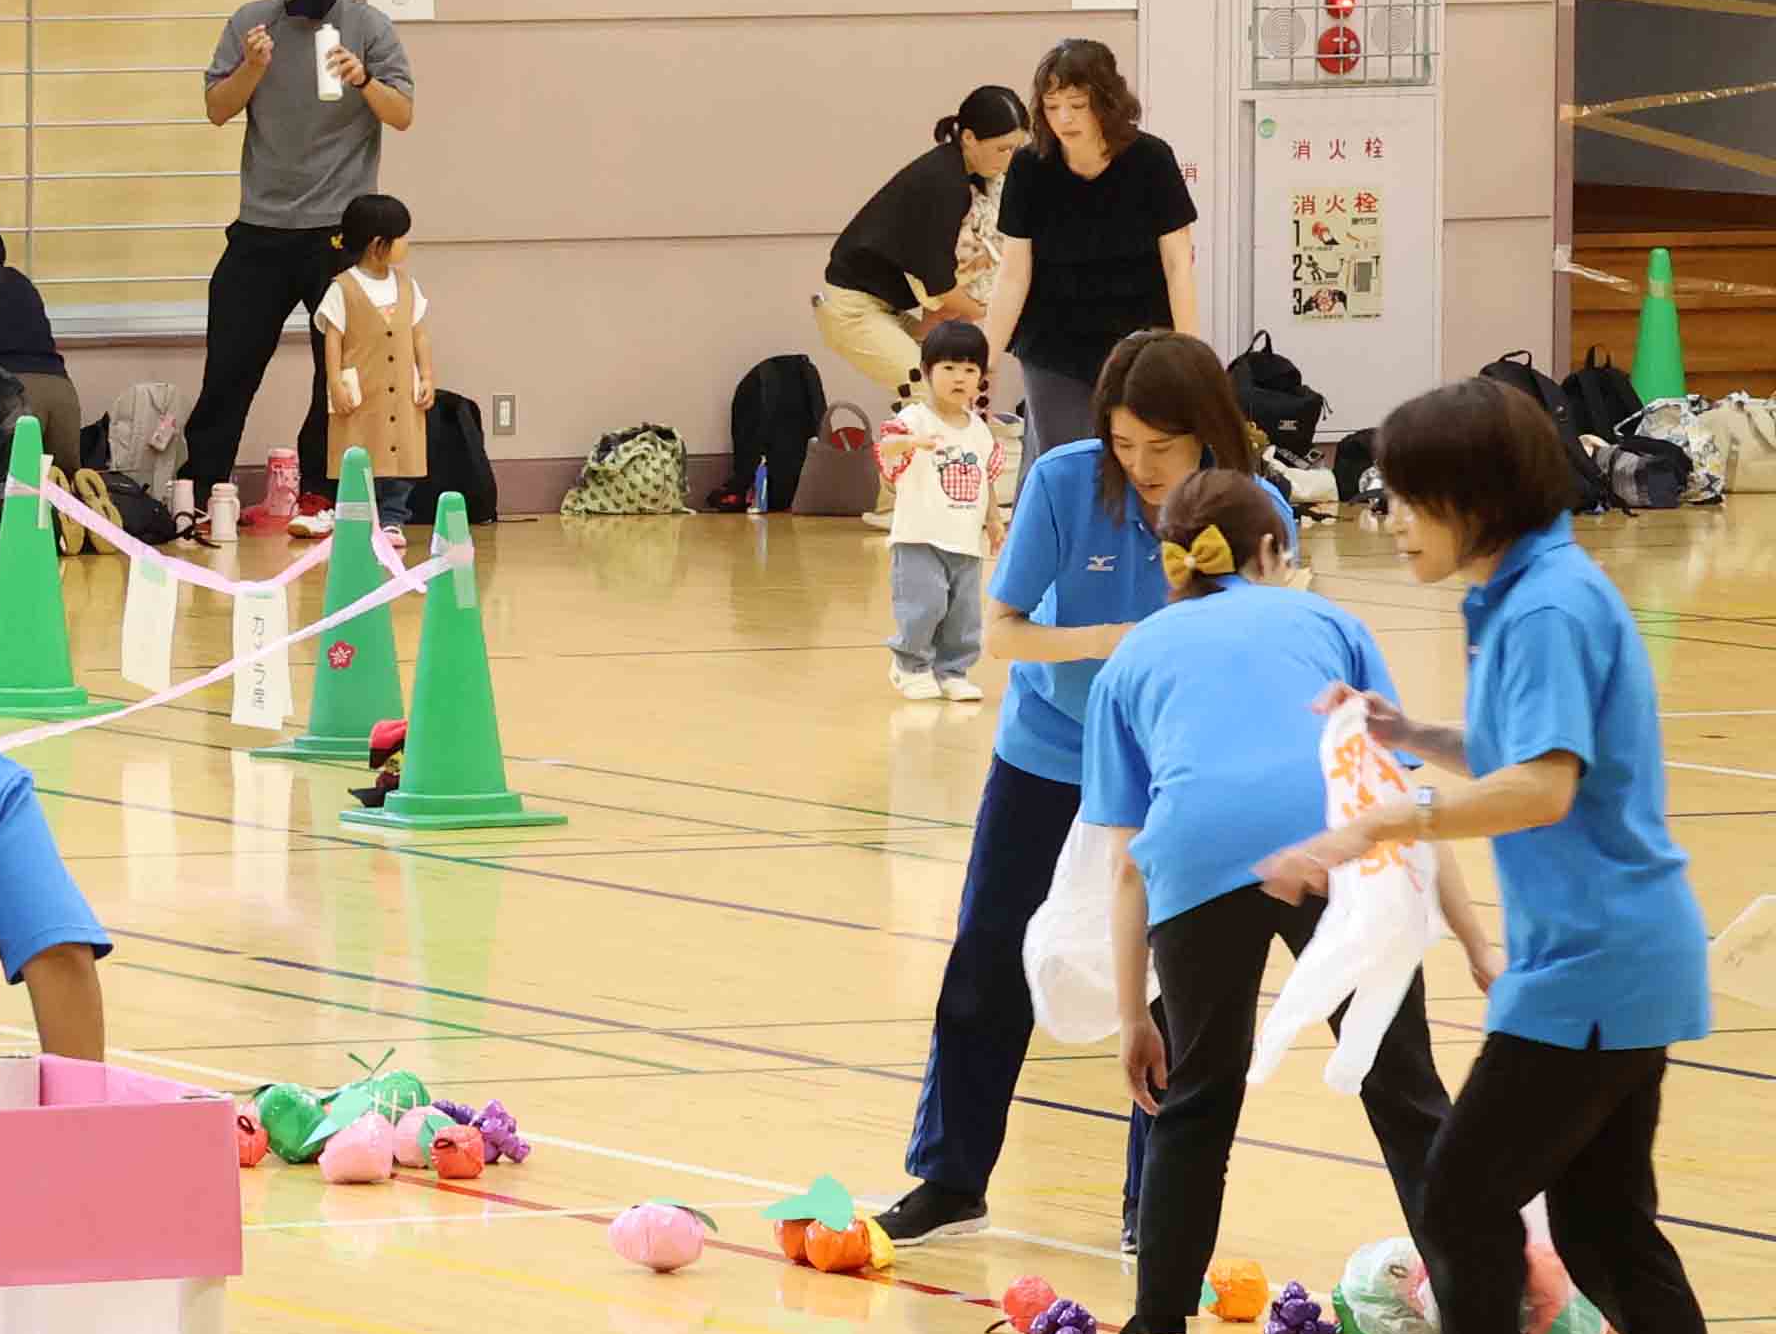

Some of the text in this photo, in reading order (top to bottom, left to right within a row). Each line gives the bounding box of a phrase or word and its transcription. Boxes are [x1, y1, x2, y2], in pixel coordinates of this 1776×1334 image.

[1292, 137, 1385, 160] 消火栓
[1293, 192, 1378, 216] 消火栓
[1292, 254, 1303, 282] 2
[1292, 287, 1303, 316] 3
